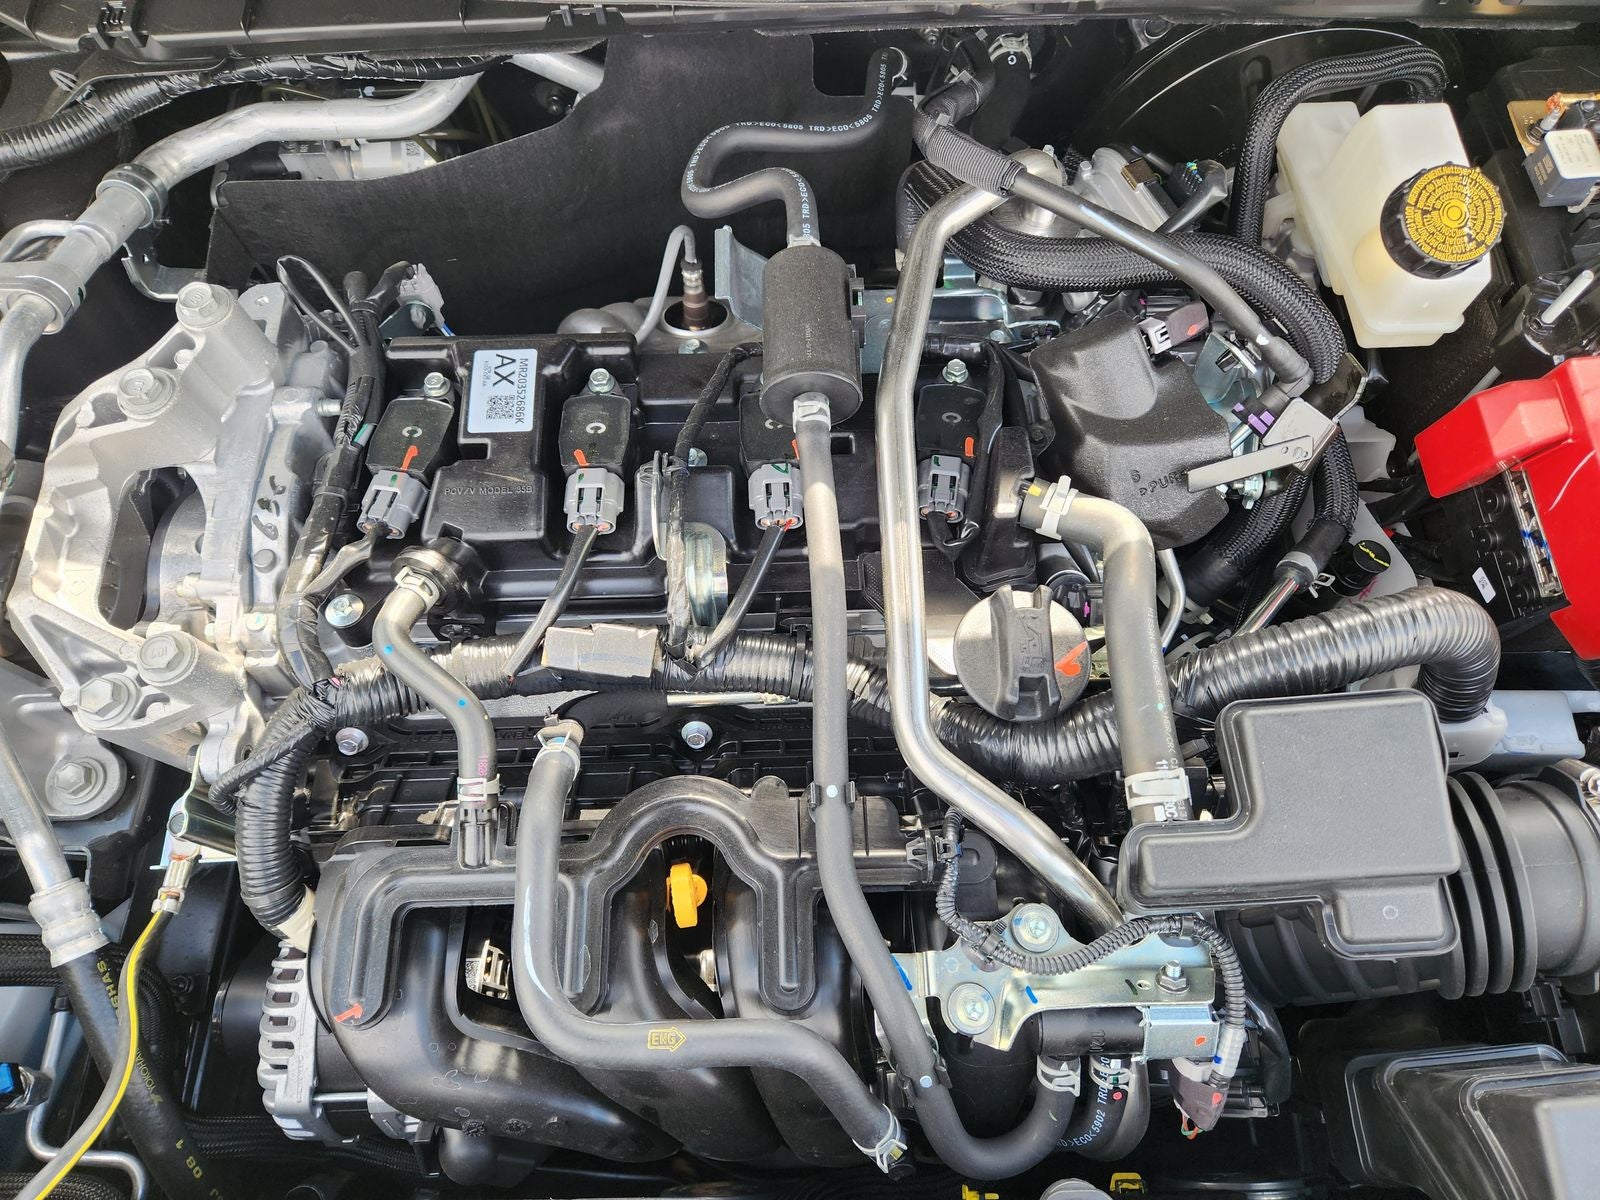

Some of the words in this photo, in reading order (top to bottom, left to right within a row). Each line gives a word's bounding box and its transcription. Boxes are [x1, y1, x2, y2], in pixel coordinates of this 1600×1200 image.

[492, 353, 517, 387] AX
[514, 358, 529, 424] MR20352686K
[479, 486, 513, 495] MODEL
[652, 1032, 677, 1046] ENG
